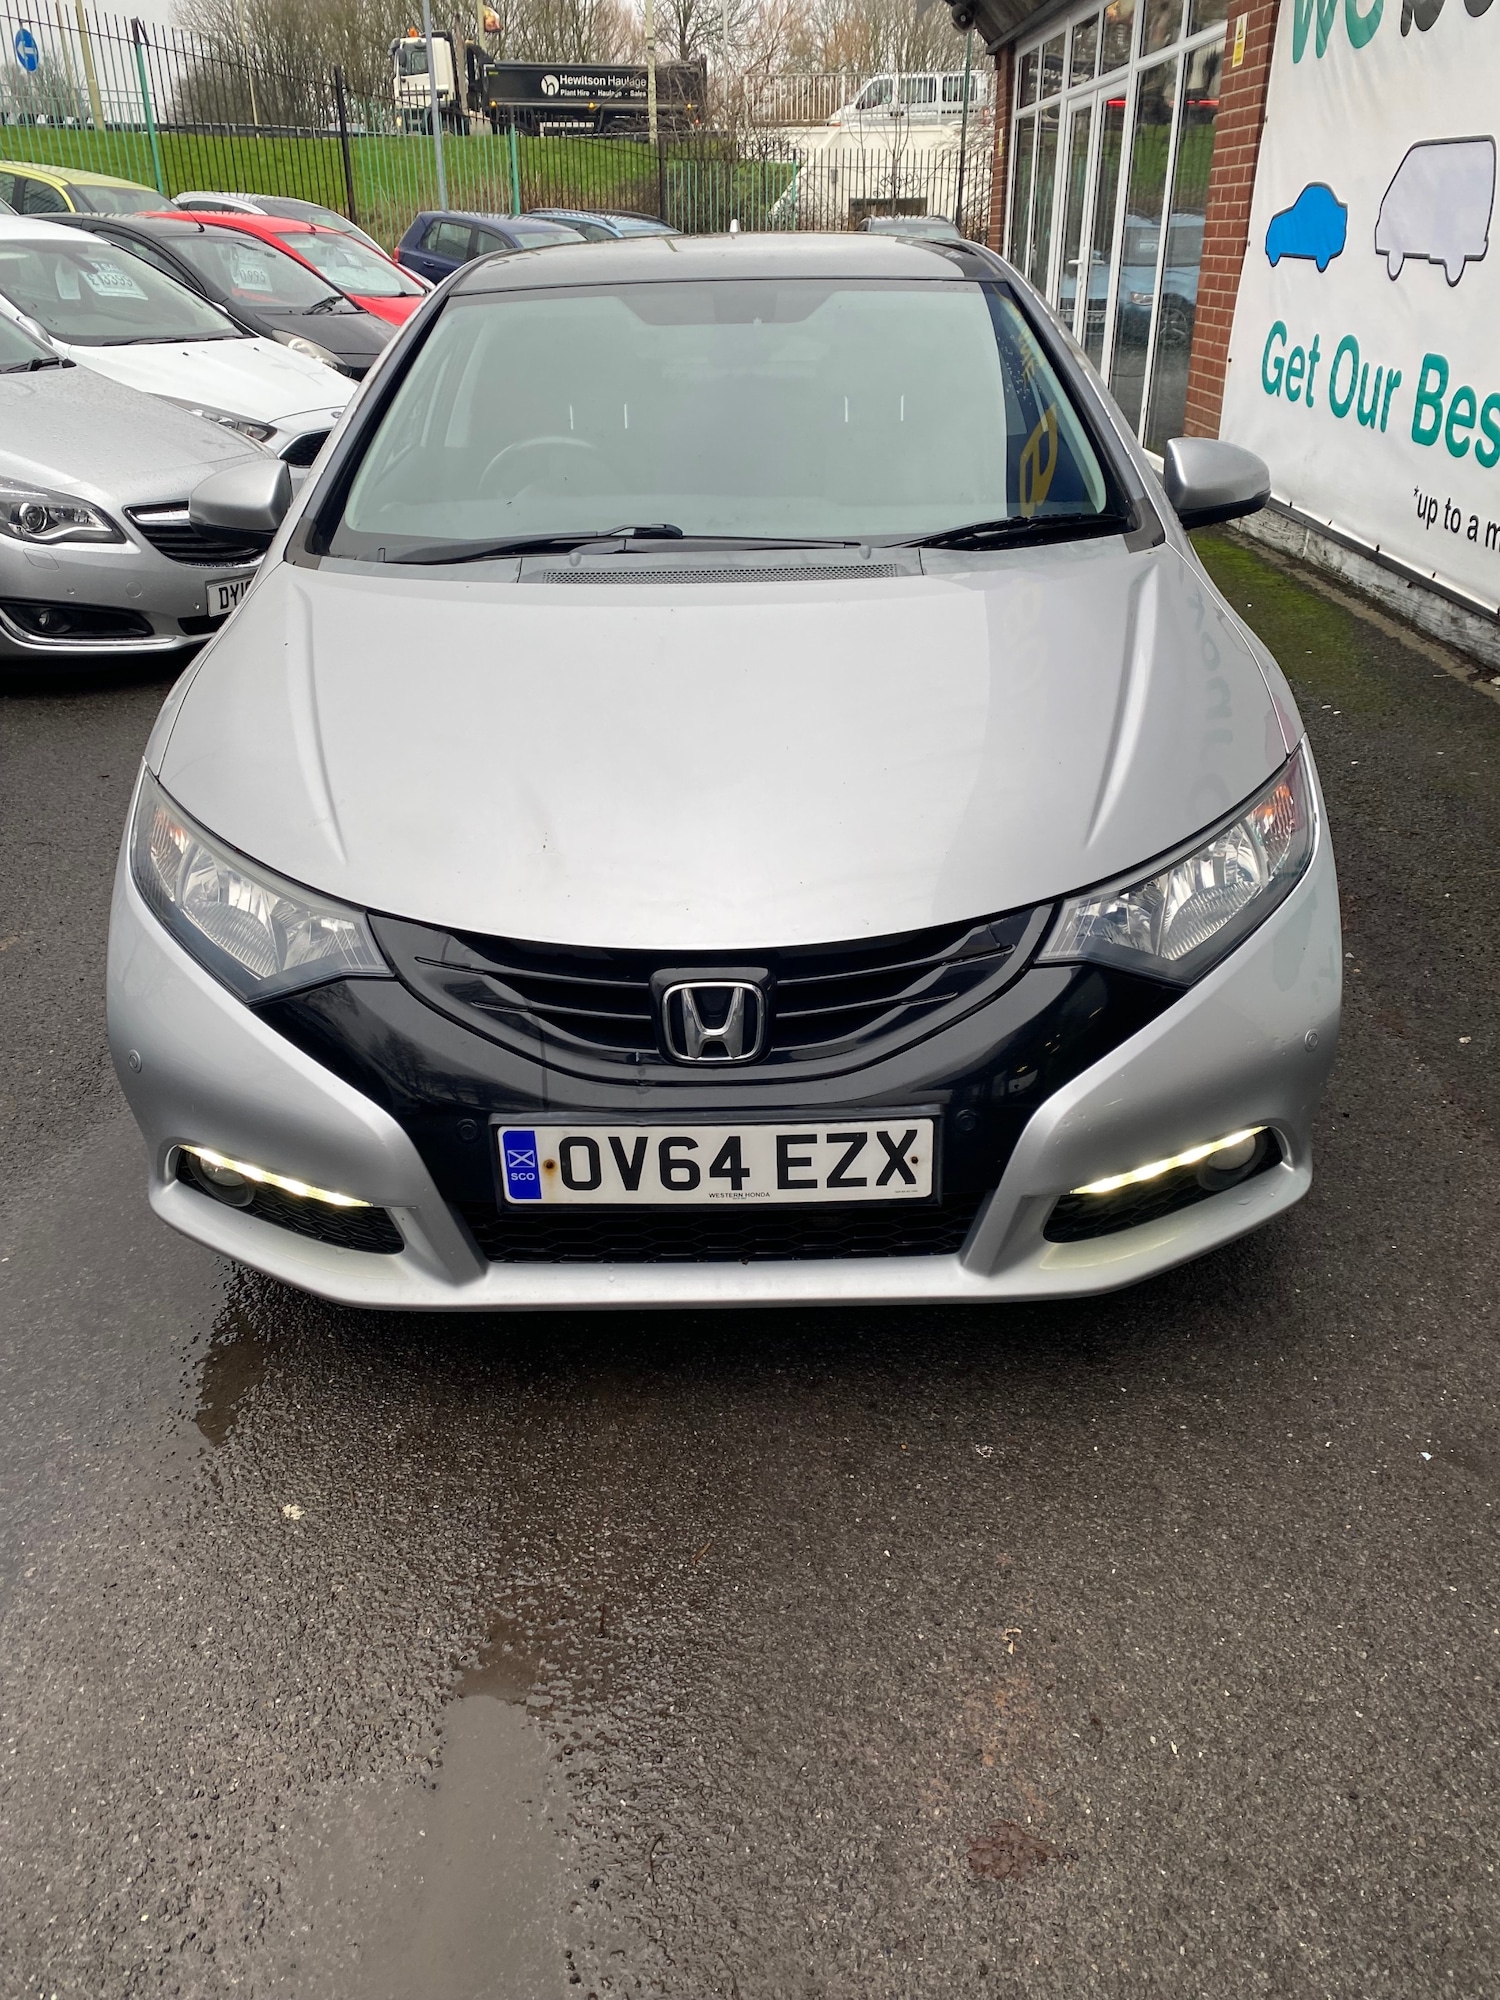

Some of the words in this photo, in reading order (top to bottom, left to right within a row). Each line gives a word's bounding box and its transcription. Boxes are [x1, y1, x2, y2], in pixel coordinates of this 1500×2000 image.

[560, 75, 606, 85] Hewitson
[607, 75, 647, 88] Haulage
[629, 89, 647, 97] Sales
[1261, 320, 1321, 408] Get
[1329, 334, 1402, 433] Our
[1411, 352, 1500, 469] Bes
[1444, 497, 1461, 533] to
[1467, 514, 1479, 542] a
[558, 1135, 750, 1191] OV64
[775, 1129, 919, 1189] EZX
[510, 1172, 535, 1181] SCO
